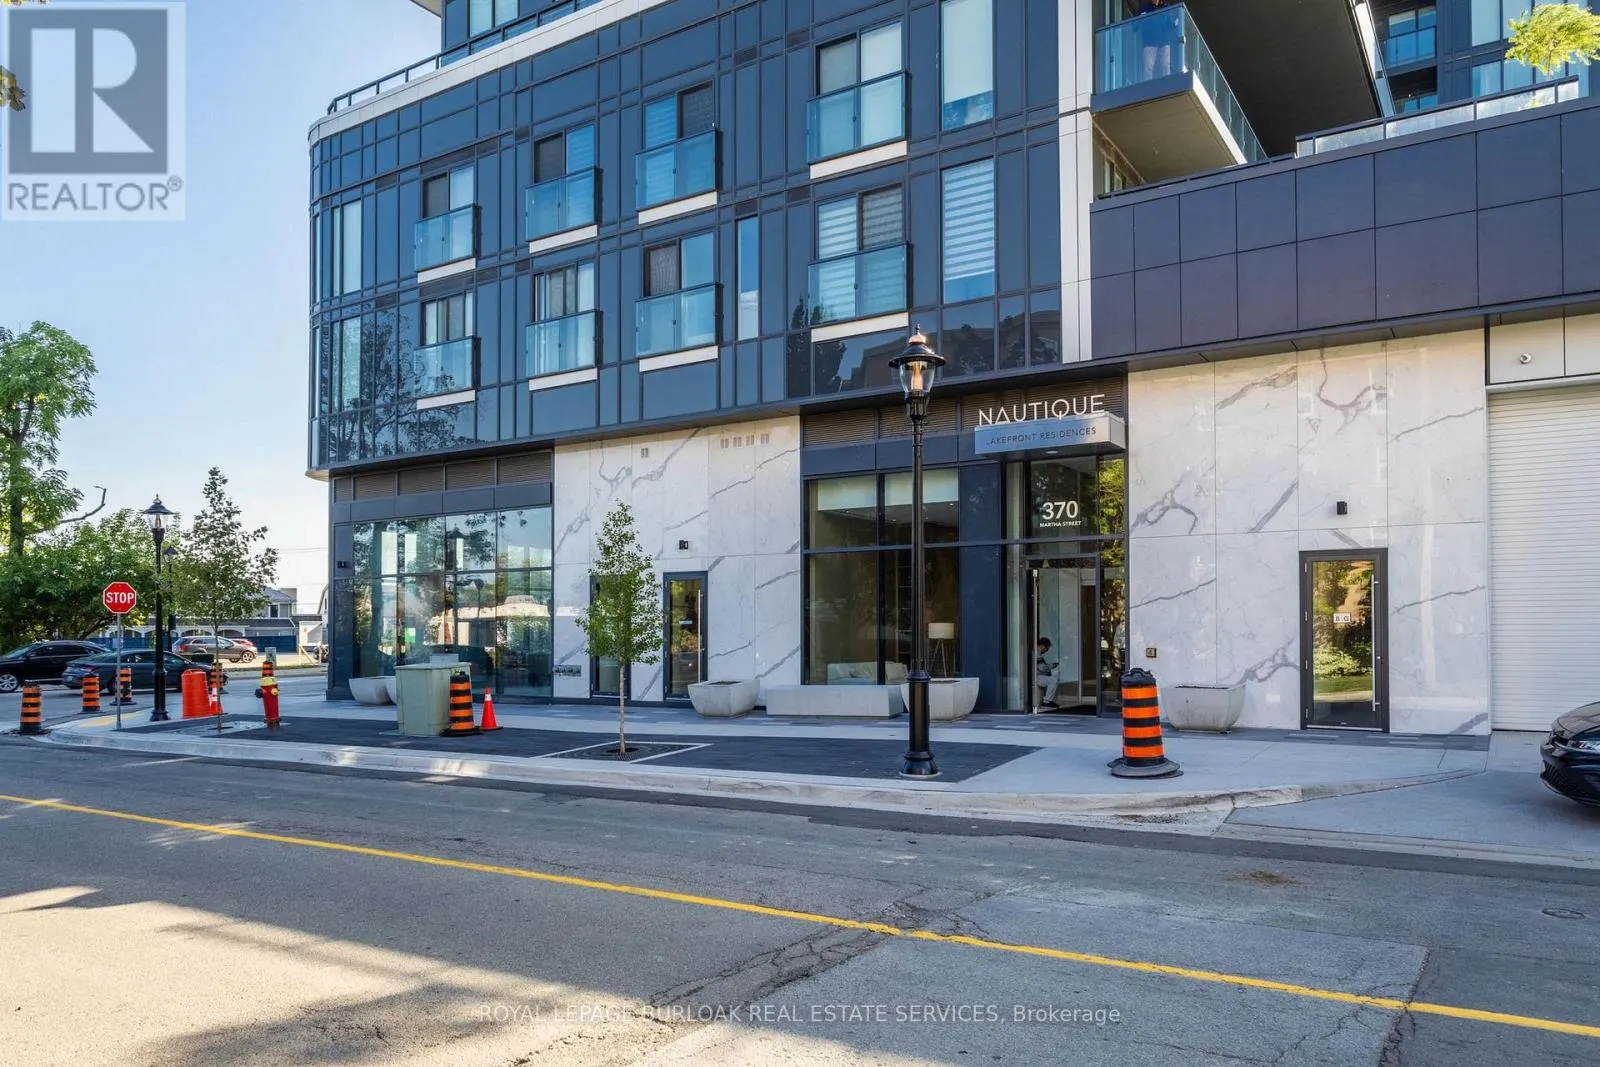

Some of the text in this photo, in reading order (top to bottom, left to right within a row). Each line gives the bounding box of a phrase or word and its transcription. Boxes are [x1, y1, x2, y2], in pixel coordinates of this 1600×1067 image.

[978, 394, 1106, 426] NAUTIQUE
[986, 426, 1097, 446] LAKEFRONT RESIDENCES
[1042, 500, 1079, 520] 370
[106, 591, 135, 604] STOP
